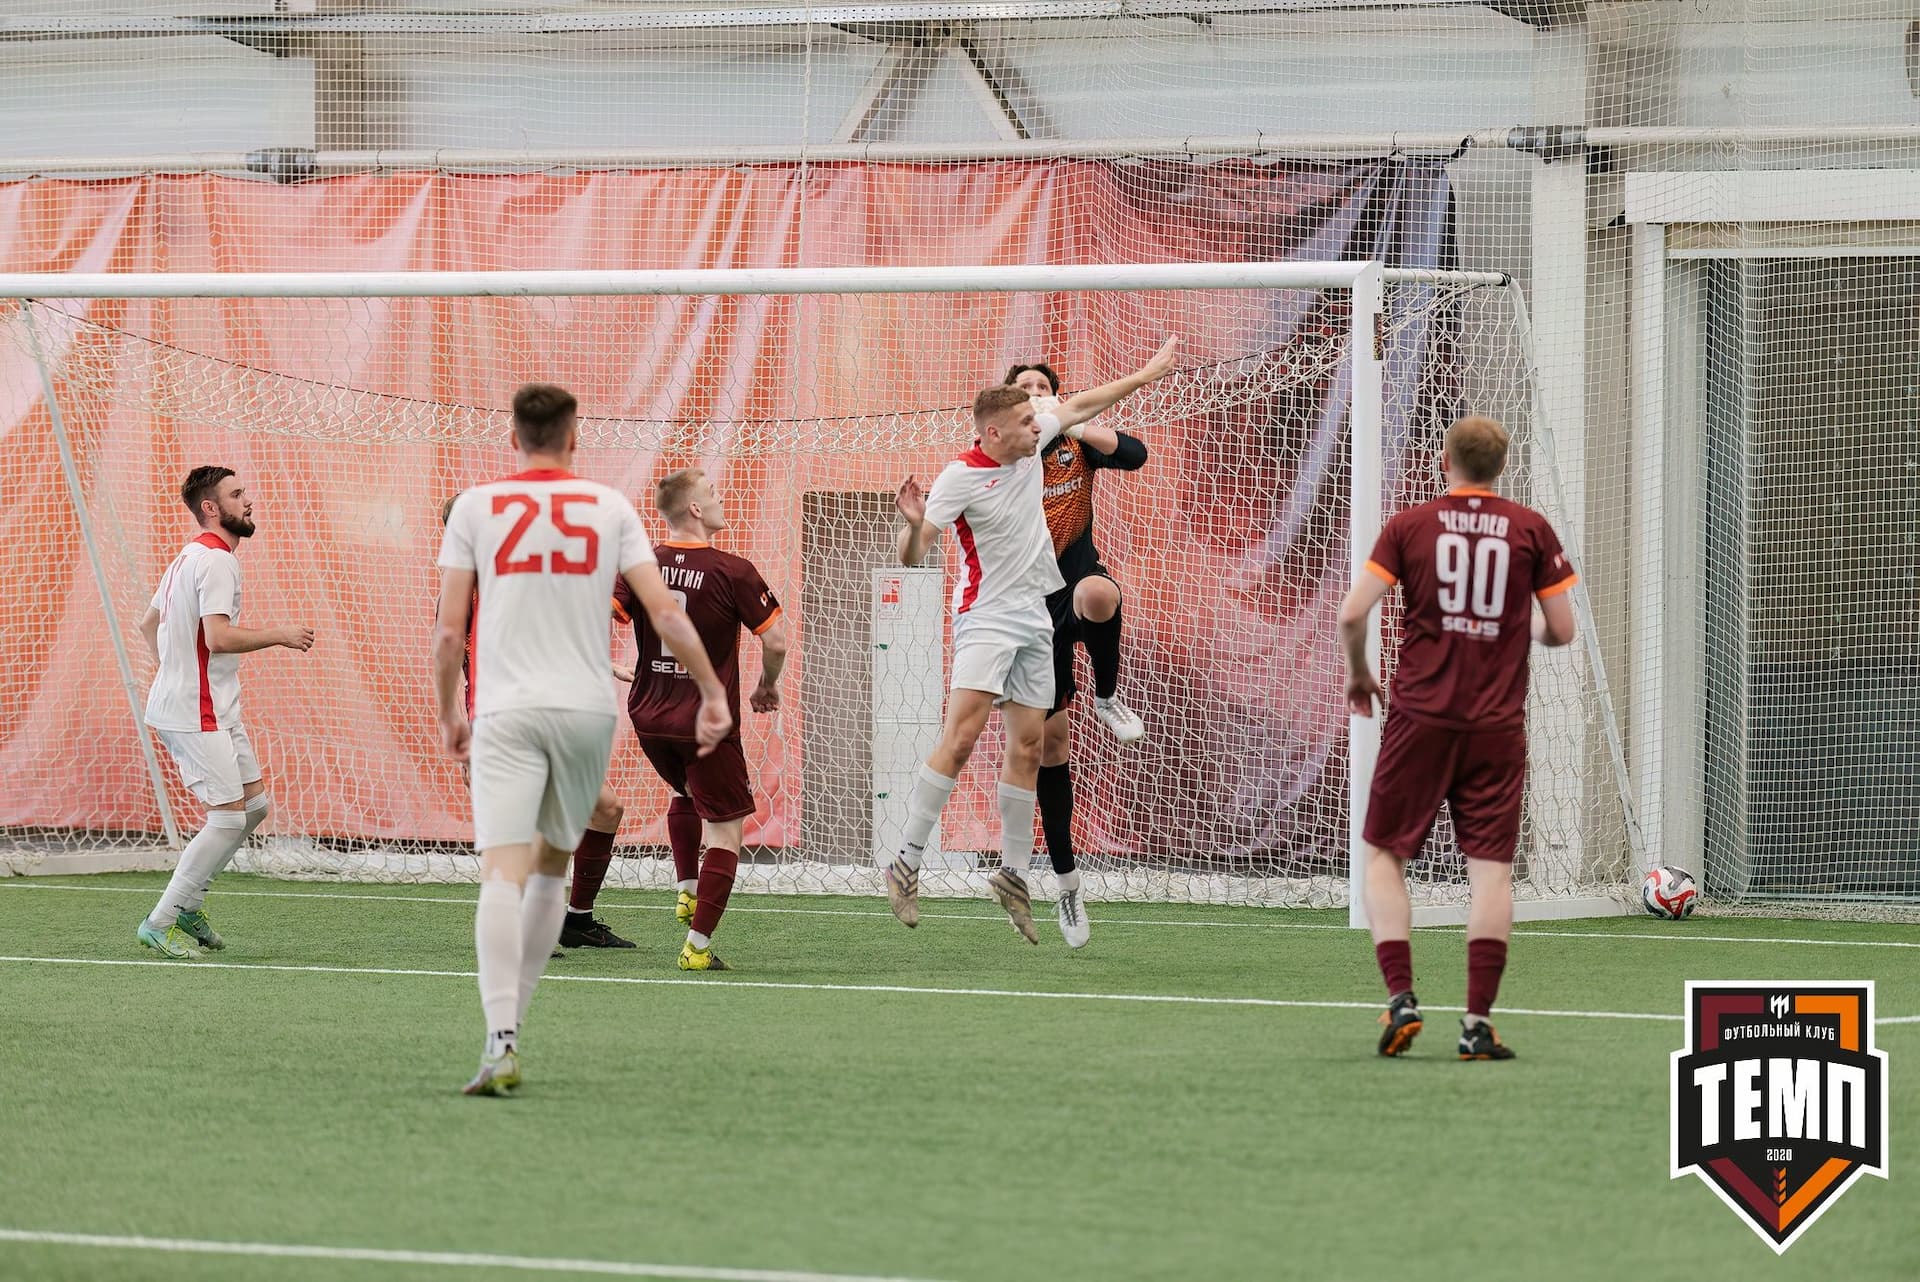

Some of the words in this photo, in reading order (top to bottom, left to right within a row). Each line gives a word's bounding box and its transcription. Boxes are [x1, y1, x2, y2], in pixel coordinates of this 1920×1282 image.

[492, 494, 598, 575] 25
[1438, 510, 1509, 538] ЧЕВЕЛЕВ
[1436, 532, 1510, 618] 90
